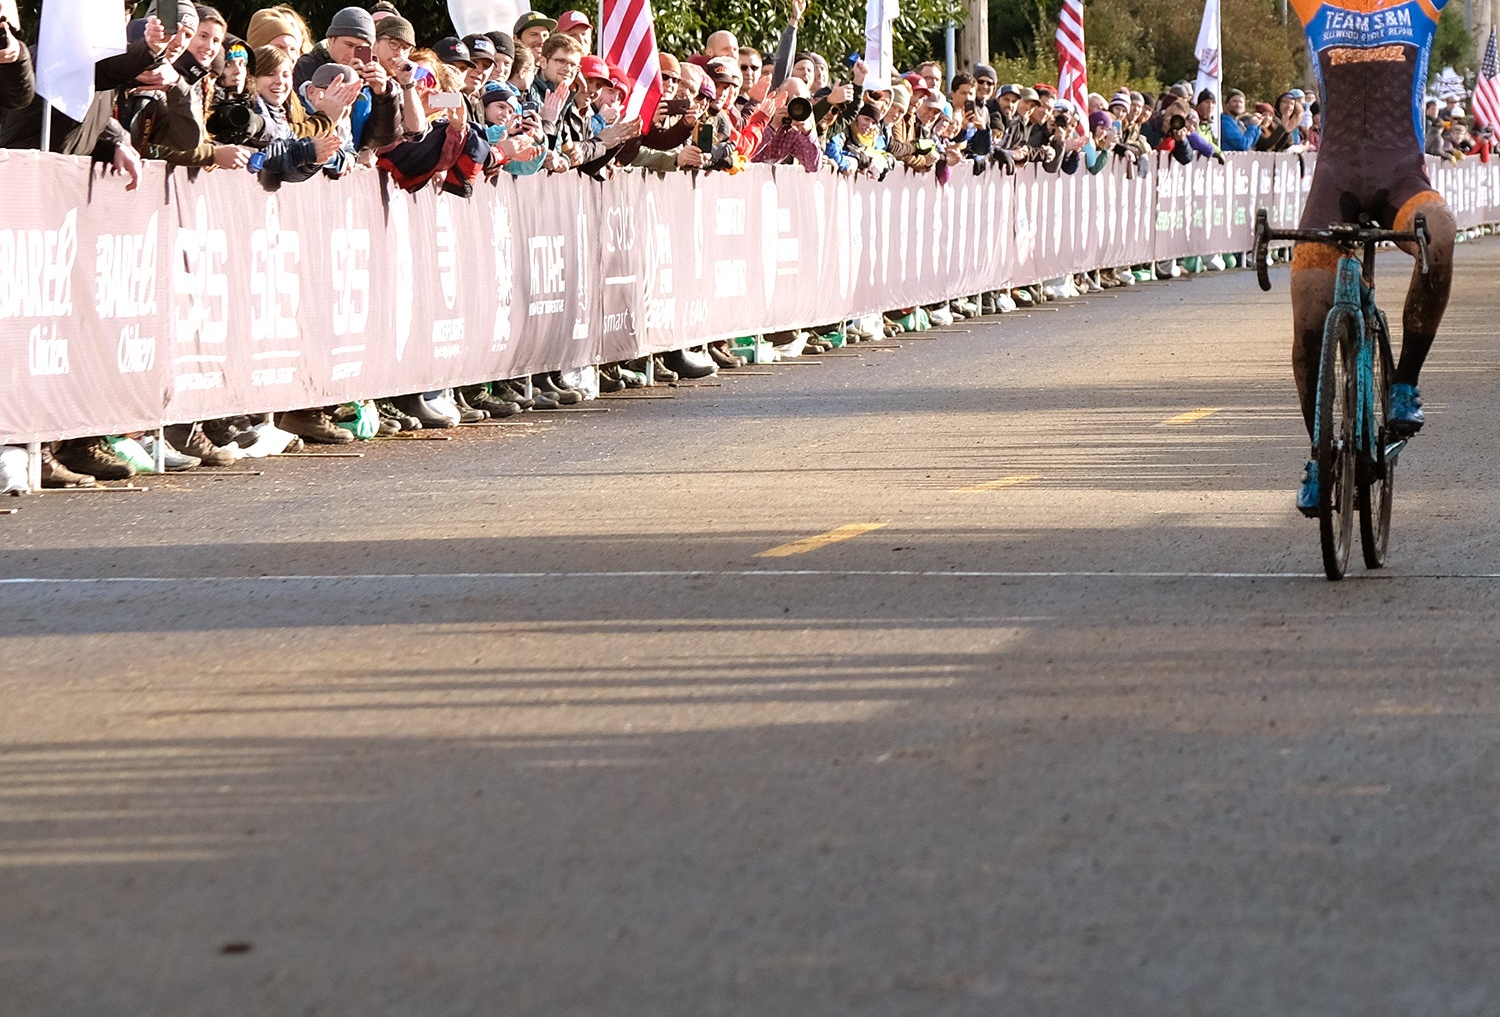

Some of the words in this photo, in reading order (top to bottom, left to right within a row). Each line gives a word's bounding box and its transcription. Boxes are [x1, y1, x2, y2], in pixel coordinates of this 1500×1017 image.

[1326, 11, 1370, 32] TEAM
[1373, 8, 1412, 30] S&M
[1388, 27, 1414, 37] REPAIR
